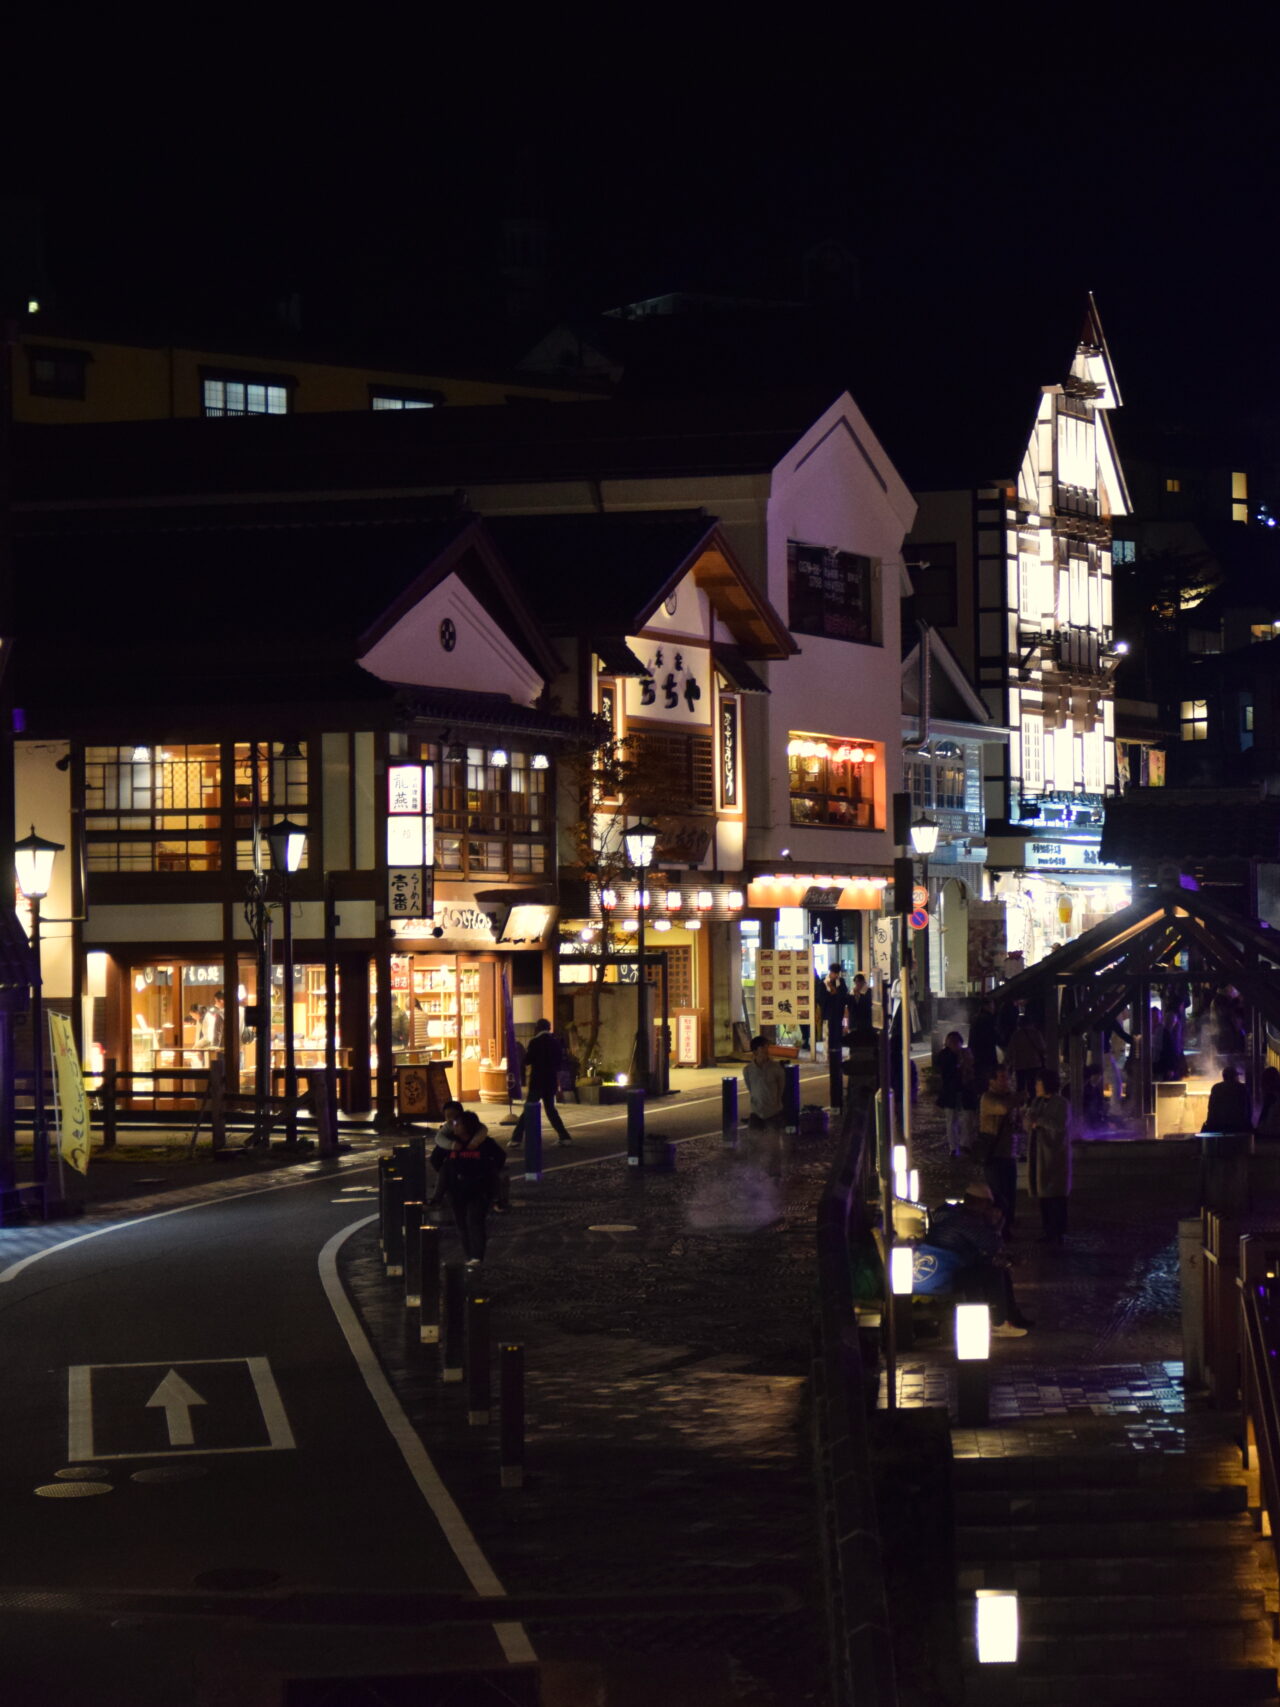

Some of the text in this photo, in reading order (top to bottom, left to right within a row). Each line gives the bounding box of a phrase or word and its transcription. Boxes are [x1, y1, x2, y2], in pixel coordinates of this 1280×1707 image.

[639, 673, 701, 713] ちちや
[391, 873, 409, 911] 壱番
[410, 873, 421, 912] らーめん
